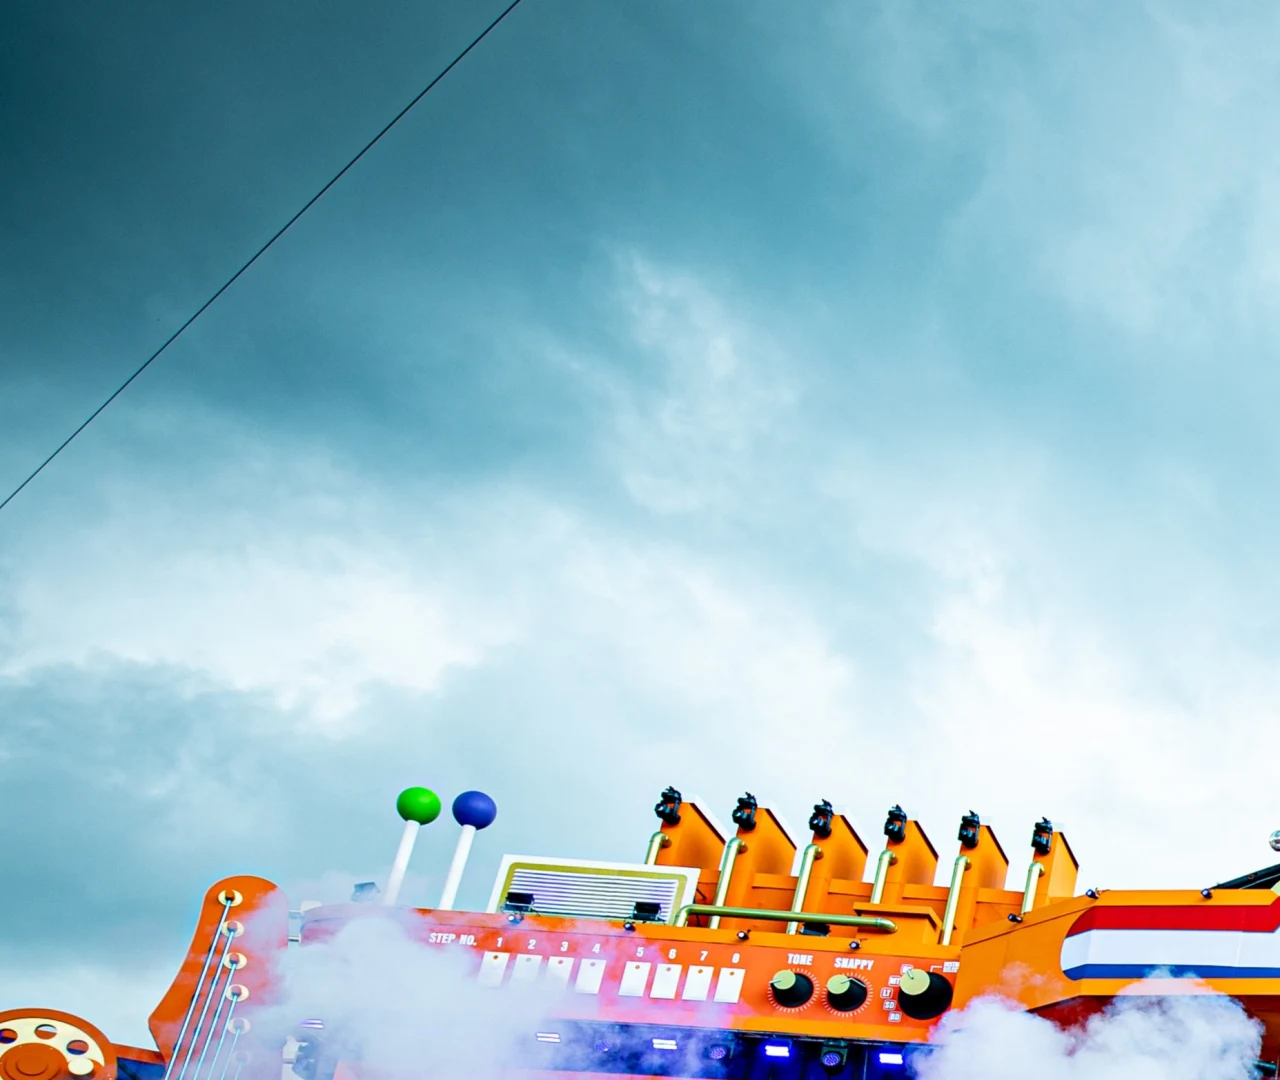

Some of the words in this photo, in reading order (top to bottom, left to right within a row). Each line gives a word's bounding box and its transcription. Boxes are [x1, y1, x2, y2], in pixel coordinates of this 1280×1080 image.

[429, 932, 456, 944] STEP
[459, 934, 477, 946] NO.
[496, 937, 503, 948] 1
[528, 939, 536, 950] 2
[560, 941, 568, 952] 3
[592, 943, 600, 954] 4
[636, 946, 644, 957] 5
[668, 948, 677, 960] 6
[700, 950, 708, 961] 7
[732, 952, 740, 964] 8
[787, 953, 814, 966] TONE
[834, 957, 874, 971] SNAPPY
